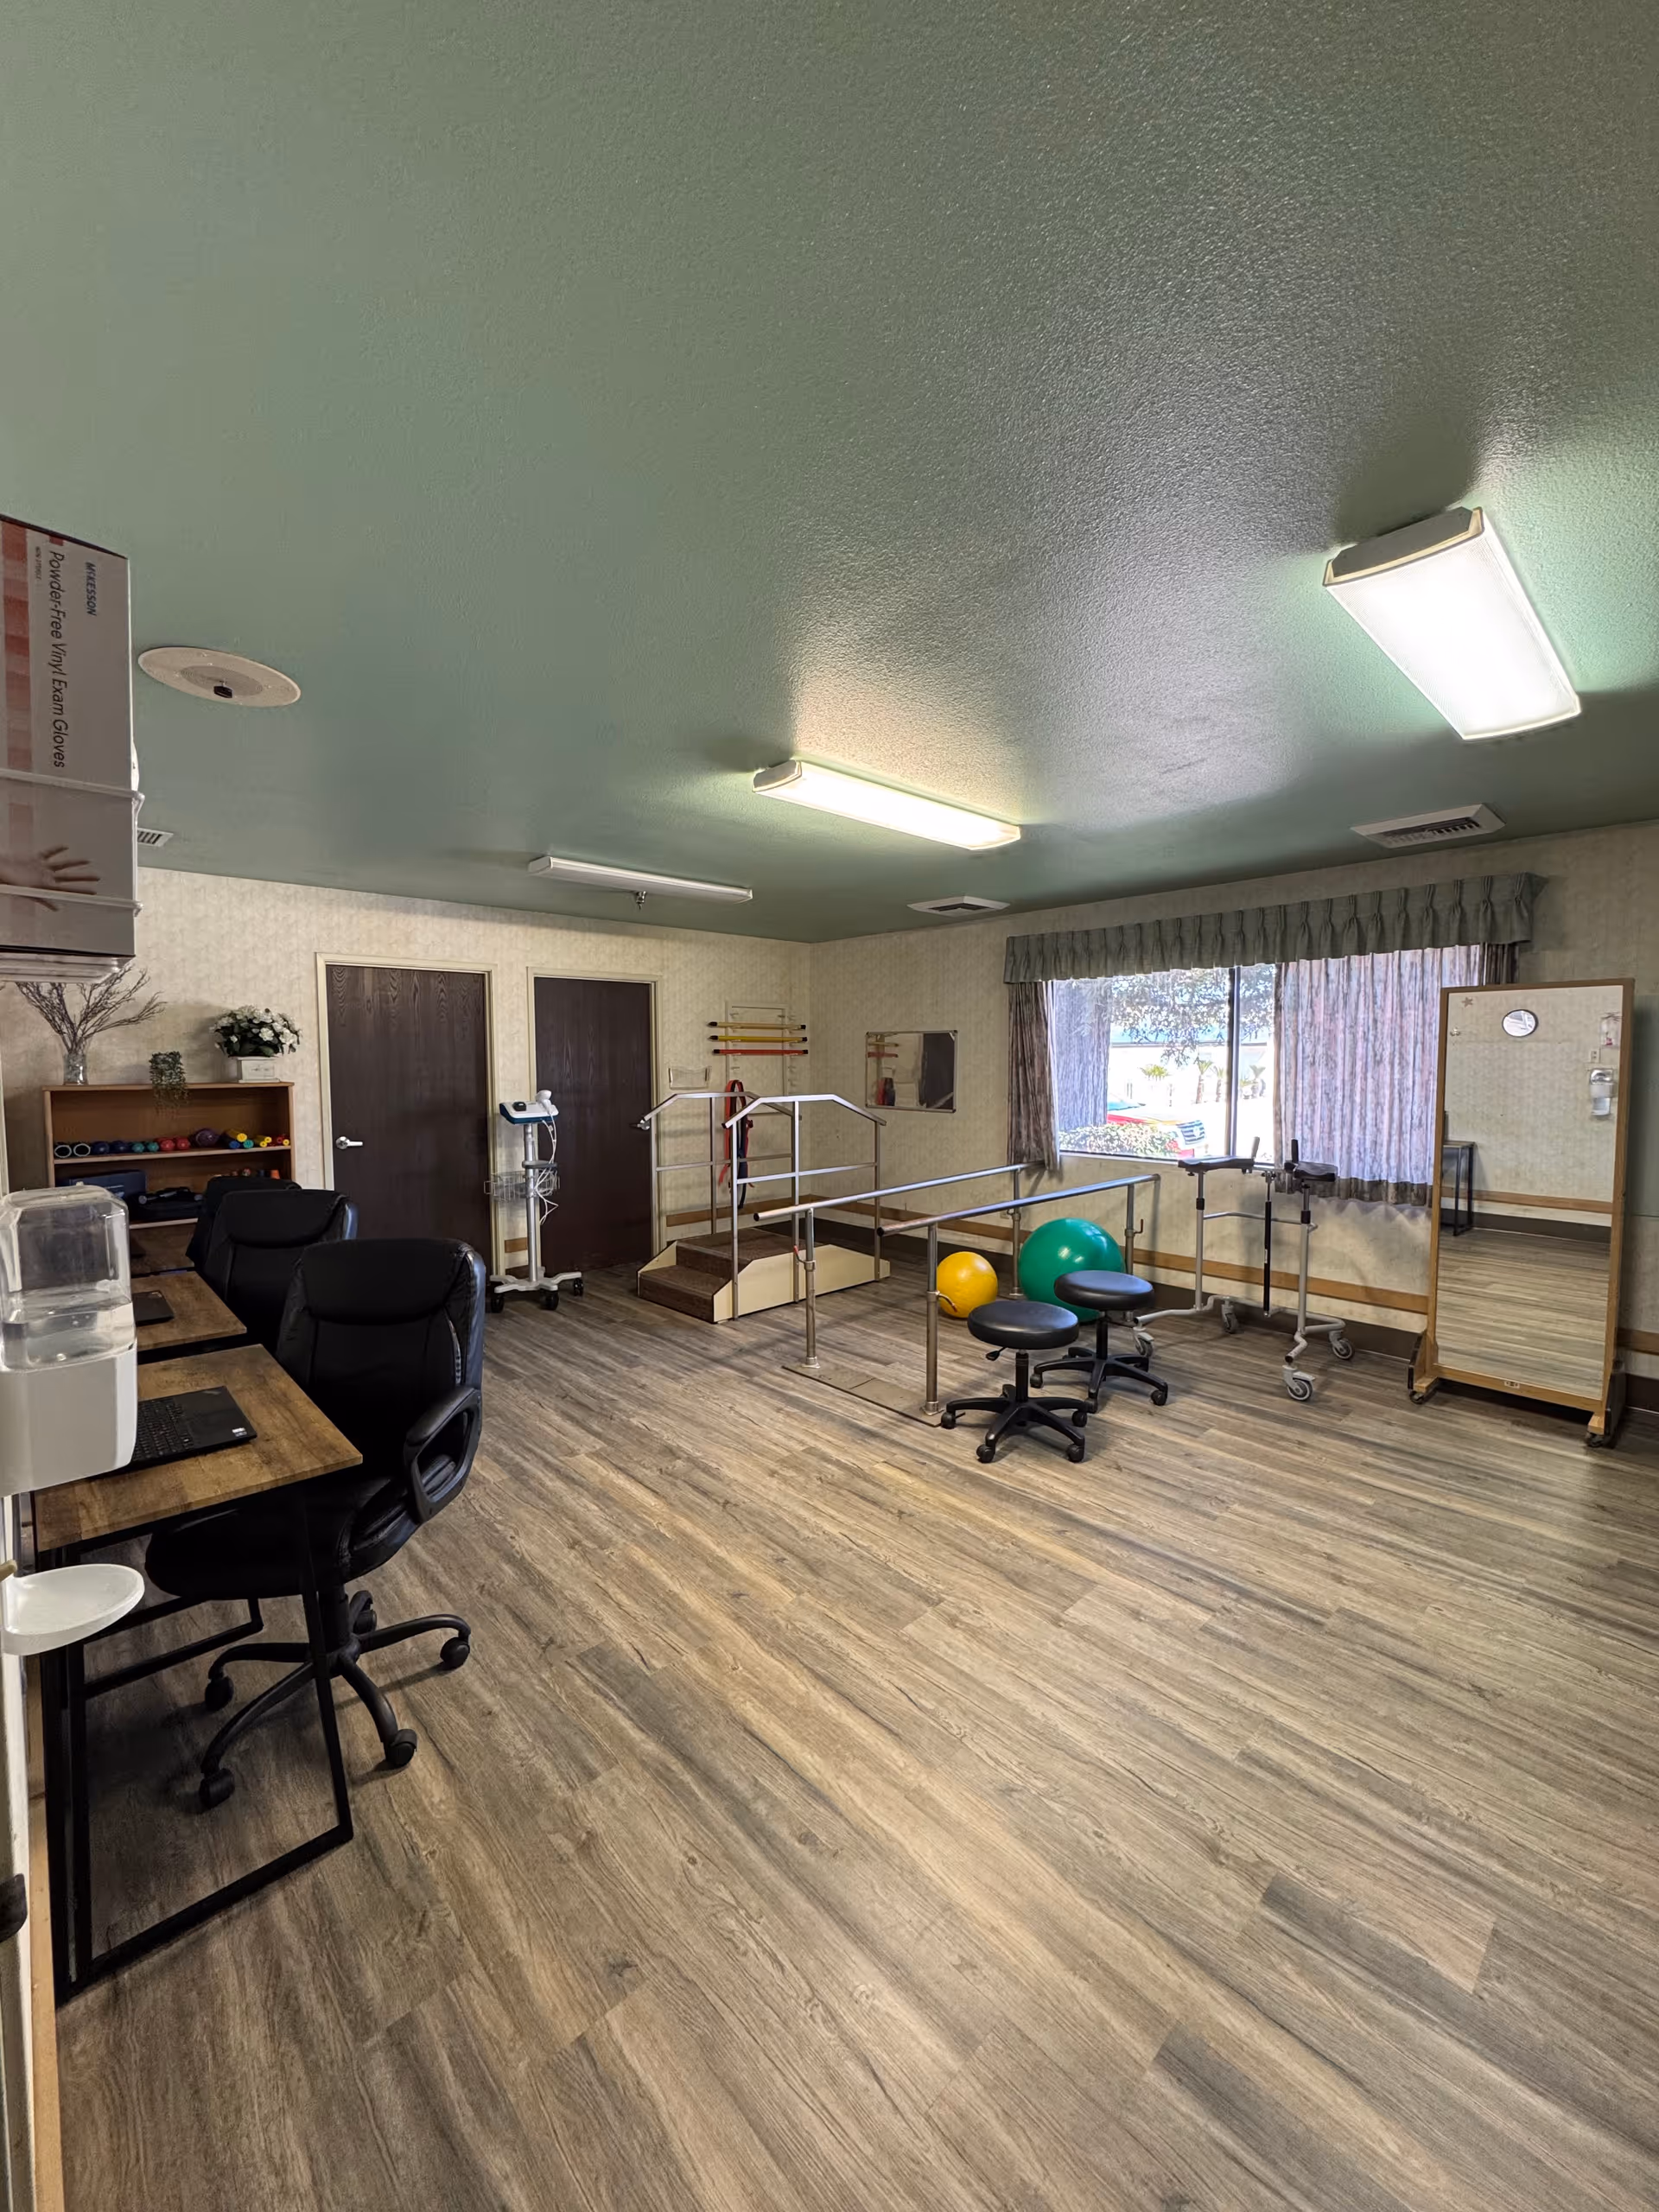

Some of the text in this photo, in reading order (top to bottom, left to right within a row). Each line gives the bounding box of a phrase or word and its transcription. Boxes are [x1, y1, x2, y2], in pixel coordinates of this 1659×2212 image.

[48, 550, 68, 767] Powder-Free Vinyl Exam Gloves
